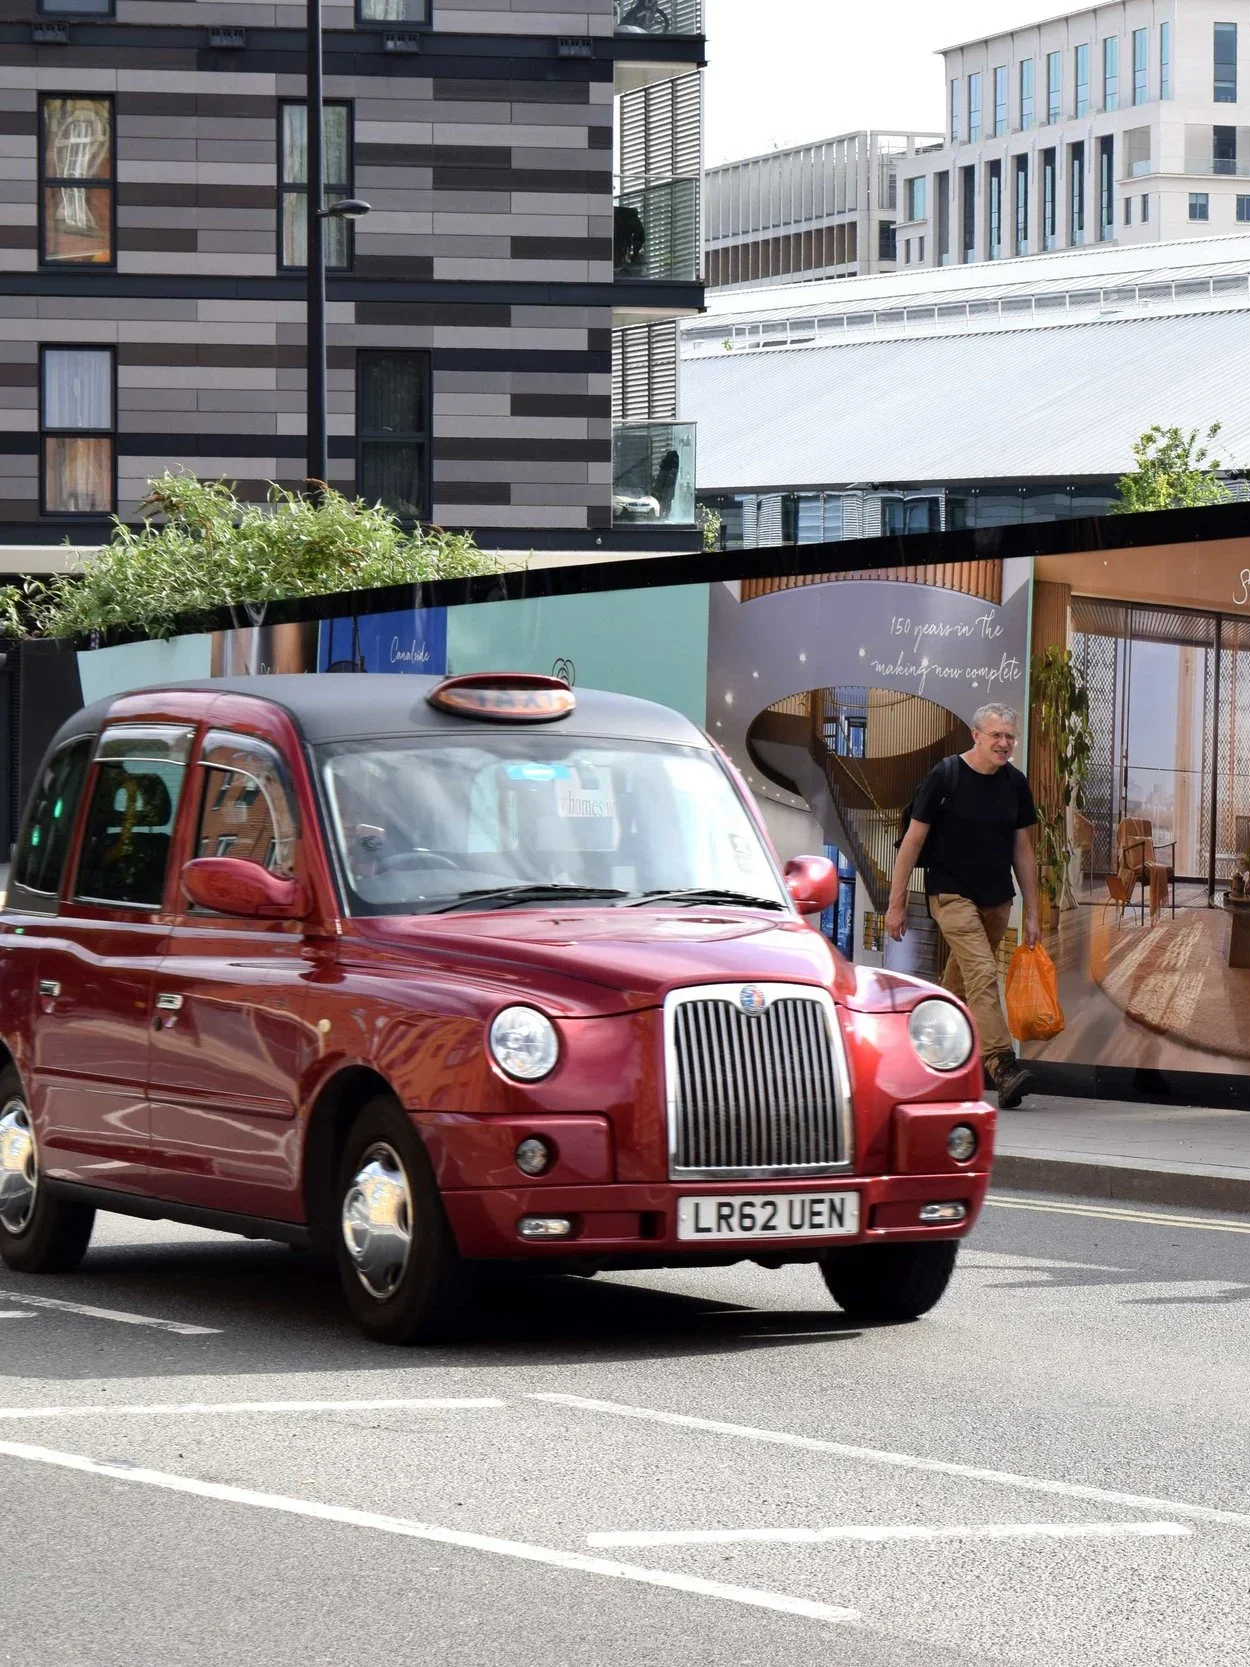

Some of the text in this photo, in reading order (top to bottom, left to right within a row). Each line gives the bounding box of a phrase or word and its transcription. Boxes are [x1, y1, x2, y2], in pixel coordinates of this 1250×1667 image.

[891, 615, 911, 636] 150
[914, 621, 952, 653] years
[955, 620, 975, 637] in
[871, 651, 1022, 695] making now complete
[694, 1197, 846, 1234] LR62 UEN
